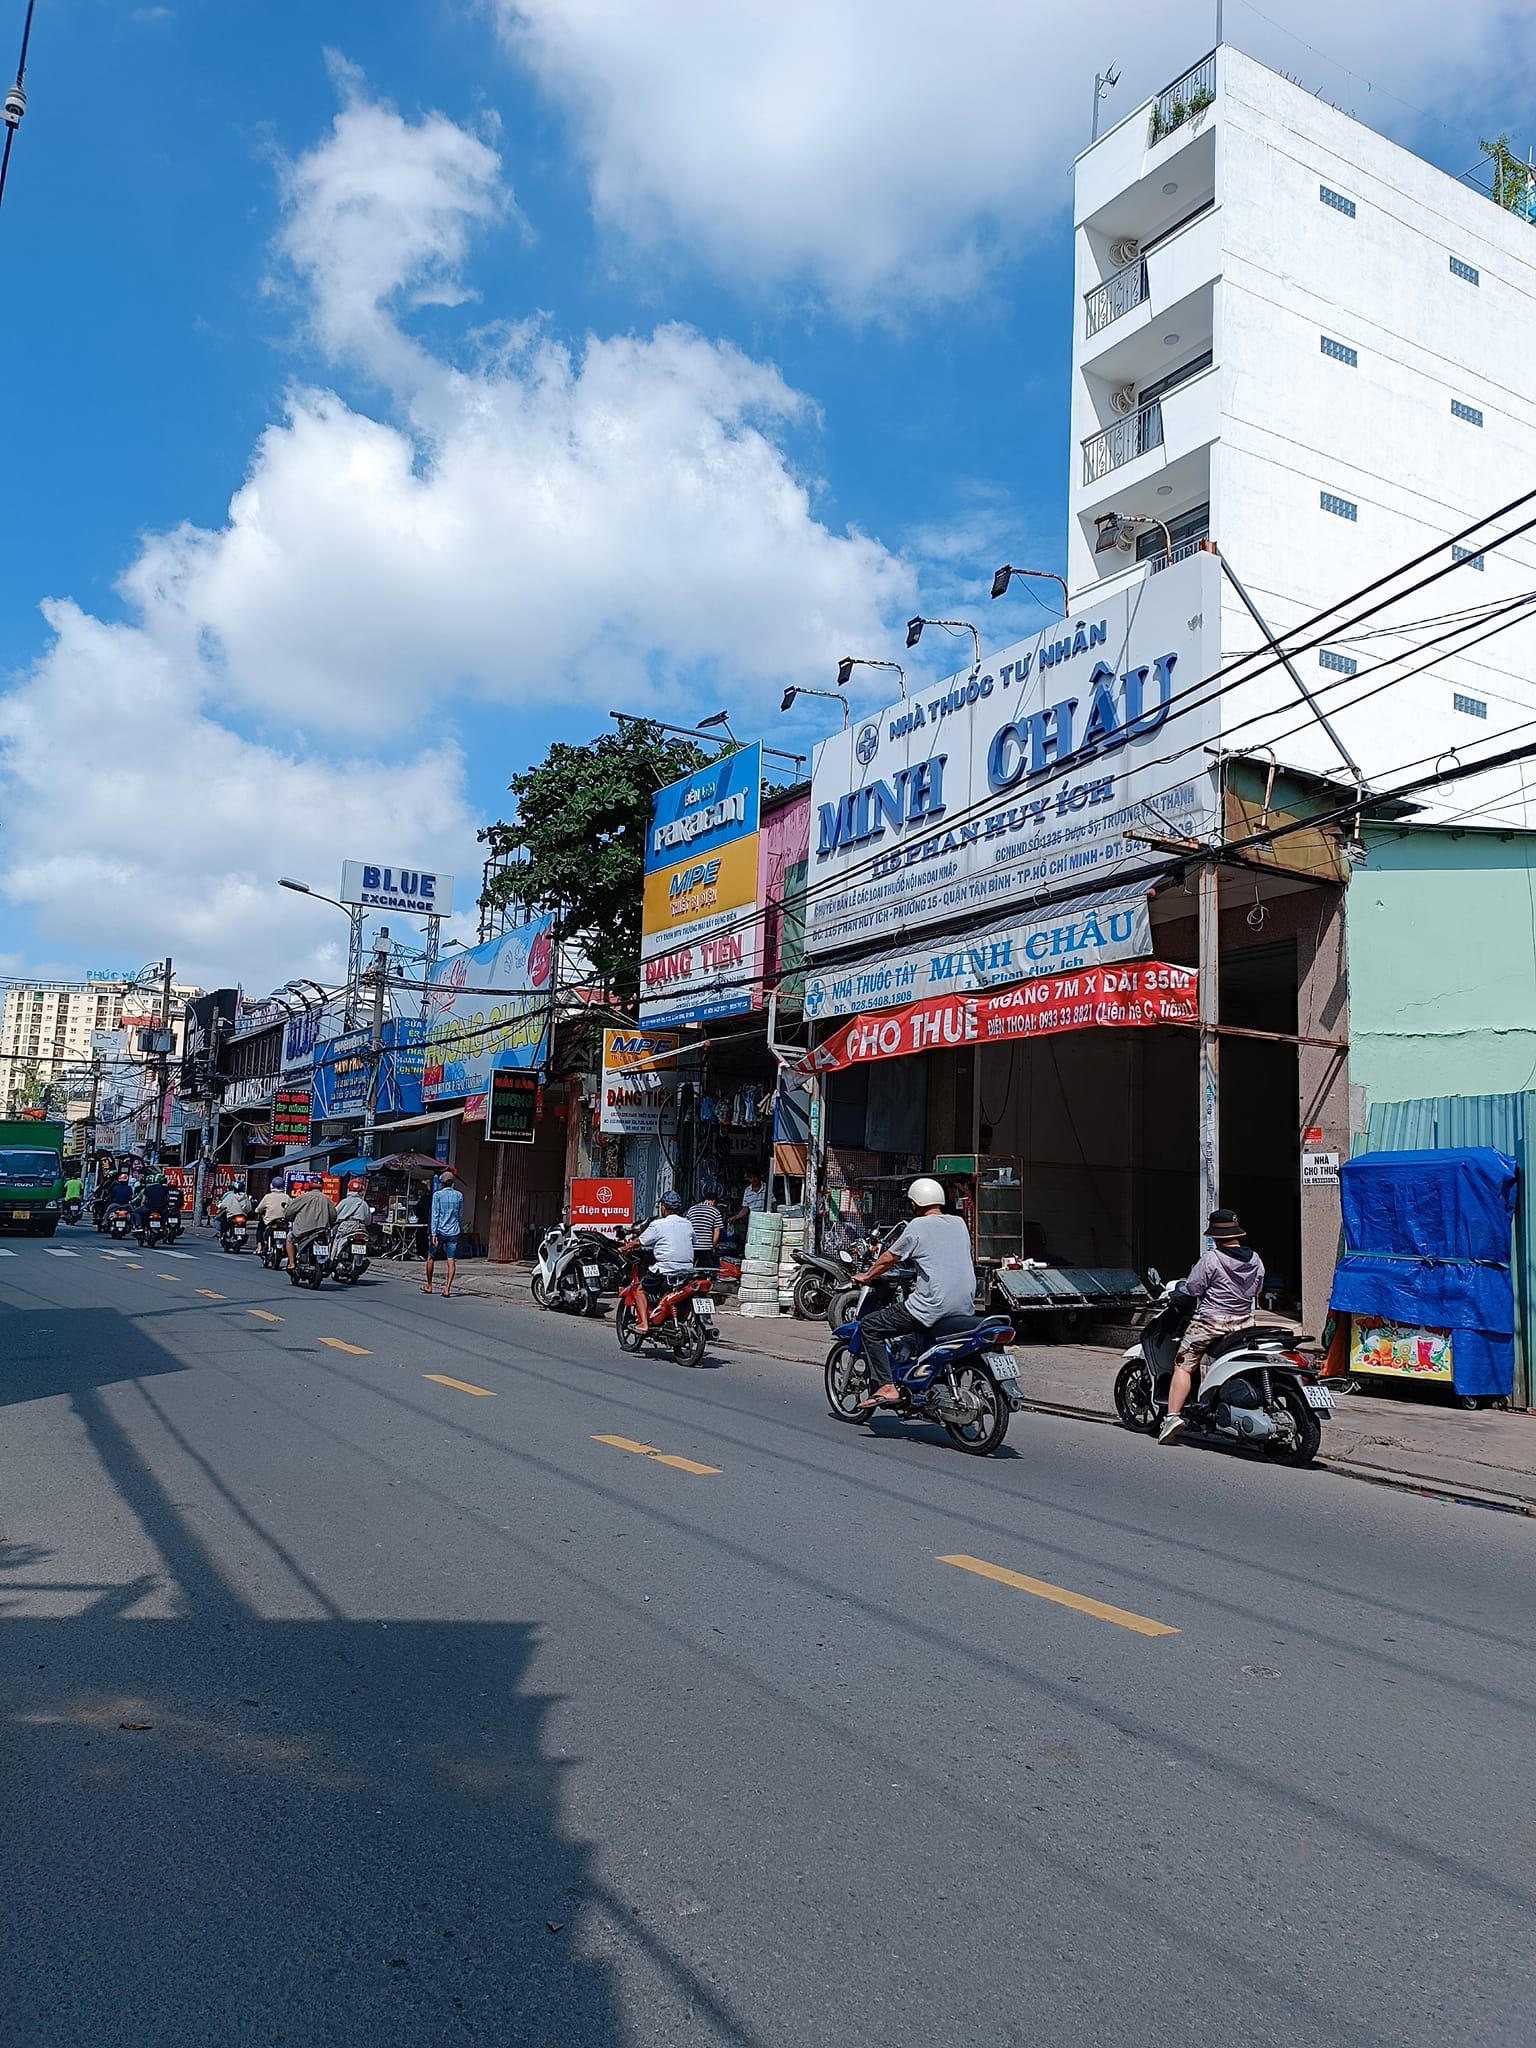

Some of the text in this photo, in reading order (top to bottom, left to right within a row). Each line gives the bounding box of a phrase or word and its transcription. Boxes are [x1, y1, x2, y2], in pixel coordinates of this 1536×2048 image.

[889, 620, 1107, 742] NHÀ THUỐC TƯ NHÂN
[816, 652, 1178, 856] MINH CHÂU
[984, 796, 1051, 836] HUY
[1056, 774, 1116, 816] ÍCH
[362, 865, 436, 898] BLUE
[668, 858, 721, 897] MPE
[859, 913, 875, 929] HUY
[927, 895, 938, 910] 15
[943, 884, 967, 907] QUẬN
[969, 880, 987, 898] TÂN
[988, 871, 1011, 891] BÌNH
[1017, 856, 1047, 882] TP.HỒ
[1049, 854, 1068, 876] CHÍ
[1069, 849, 1098, 871] MINH
[1105, 842, 1123, 859] ĐT:
[883, 874, 905, 896] THUỐC
[361, 893, 433, 911] EXCHANGE
[856, 963, 892, 995] THUỐC
[895, 961, 918, 985] TÂY
[928, 939, 1013, 983] MINH
[1025, 909, 1135, 961] CHÂU
[86, 969, 119, 981] PHÚC
[991, 970, 1023, 983] Phan
[1060, 956, 1084, 970] Ích
[988, 967, 1190, 1011] NGANG 7M X DÀI 35M
[488, 983, 545, 1055] CHÂU
[846, 998, 978, 1057] CHO THUÊ
[987, 1013, 1005, 1039] ĐIỆN
[1007, 1013, 1037, 1037] THOẠI:
[1039, 1009, 1058, 1030] 0933
[1060, 1006, 1071, 1025] 33
[1073, 1003, 1093, 1024] 8821
[1095, 1002, 1125, 1025] (Liên
[1128, 1001, 1142, 1025] hệ
[1144, 1000, 1157, 1020] C.
[610, 1036, 673, 1054] MPE
[607, 1086, 641, 1110] ĐẶNG
[1304, 1164, 1338, 1176] CHO THUÊ
[1314, 1154, 1330, 1165] NHÀ
[183, 1176, 194, 1186] XE
[233, 1174, 246, 1185] XE
[576, 1204, 630, 1217] điện quang
